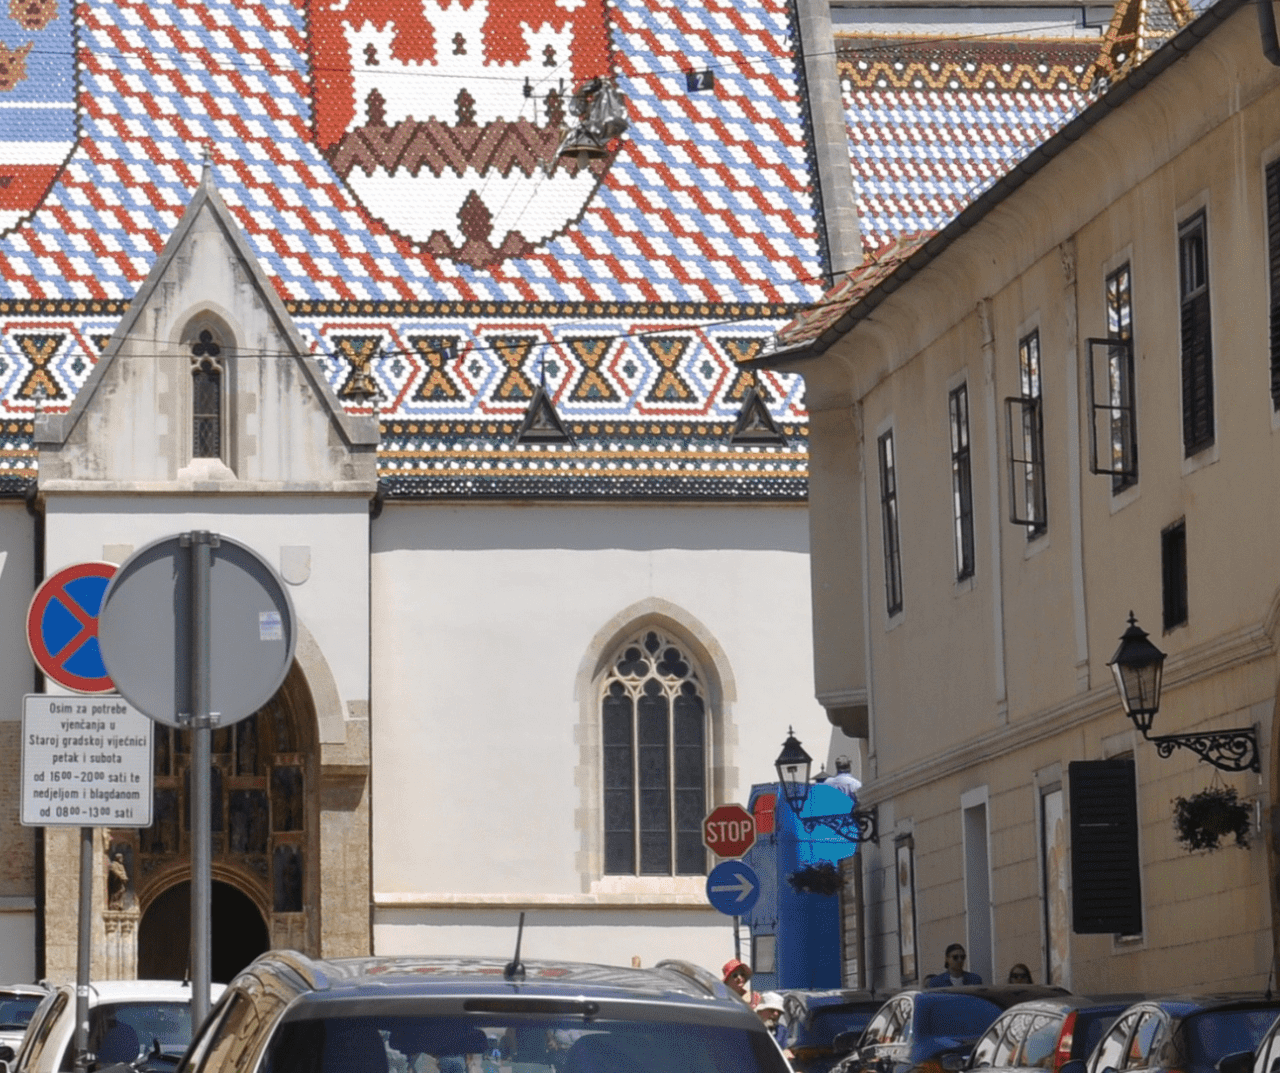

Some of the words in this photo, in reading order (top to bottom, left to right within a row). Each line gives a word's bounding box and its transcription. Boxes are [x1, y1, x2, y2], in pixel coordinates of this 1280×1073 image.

[696, 73, 704, 88] 2
[49, 702, 72, 714] Osim
[76, 705, 87, 714] za
[91, 703, 127, 716] potrebe
[61, 718, 105, 732] vjenčanja
[110, 722, 116, 730] u
[29, 734, 59, 748] Staroj
[62, 735, 104, 749] gradskoj
[107, 735, 147, 749] vijećnici
[52, 752, 79, 765] petak
[90, 752, 122, 764] subota
[33, 771, 45, 782] od
[108, 772, 127, 783] sati
[130, 772, 140, 783] te
[33, 788, 79, 801] nedjeljom
[89, 788, 140, 802] blagdanom
[39, 806, 51, 817] od
[114, 807, 133, 818] sati
[707, 820, 751, 843] STOP
